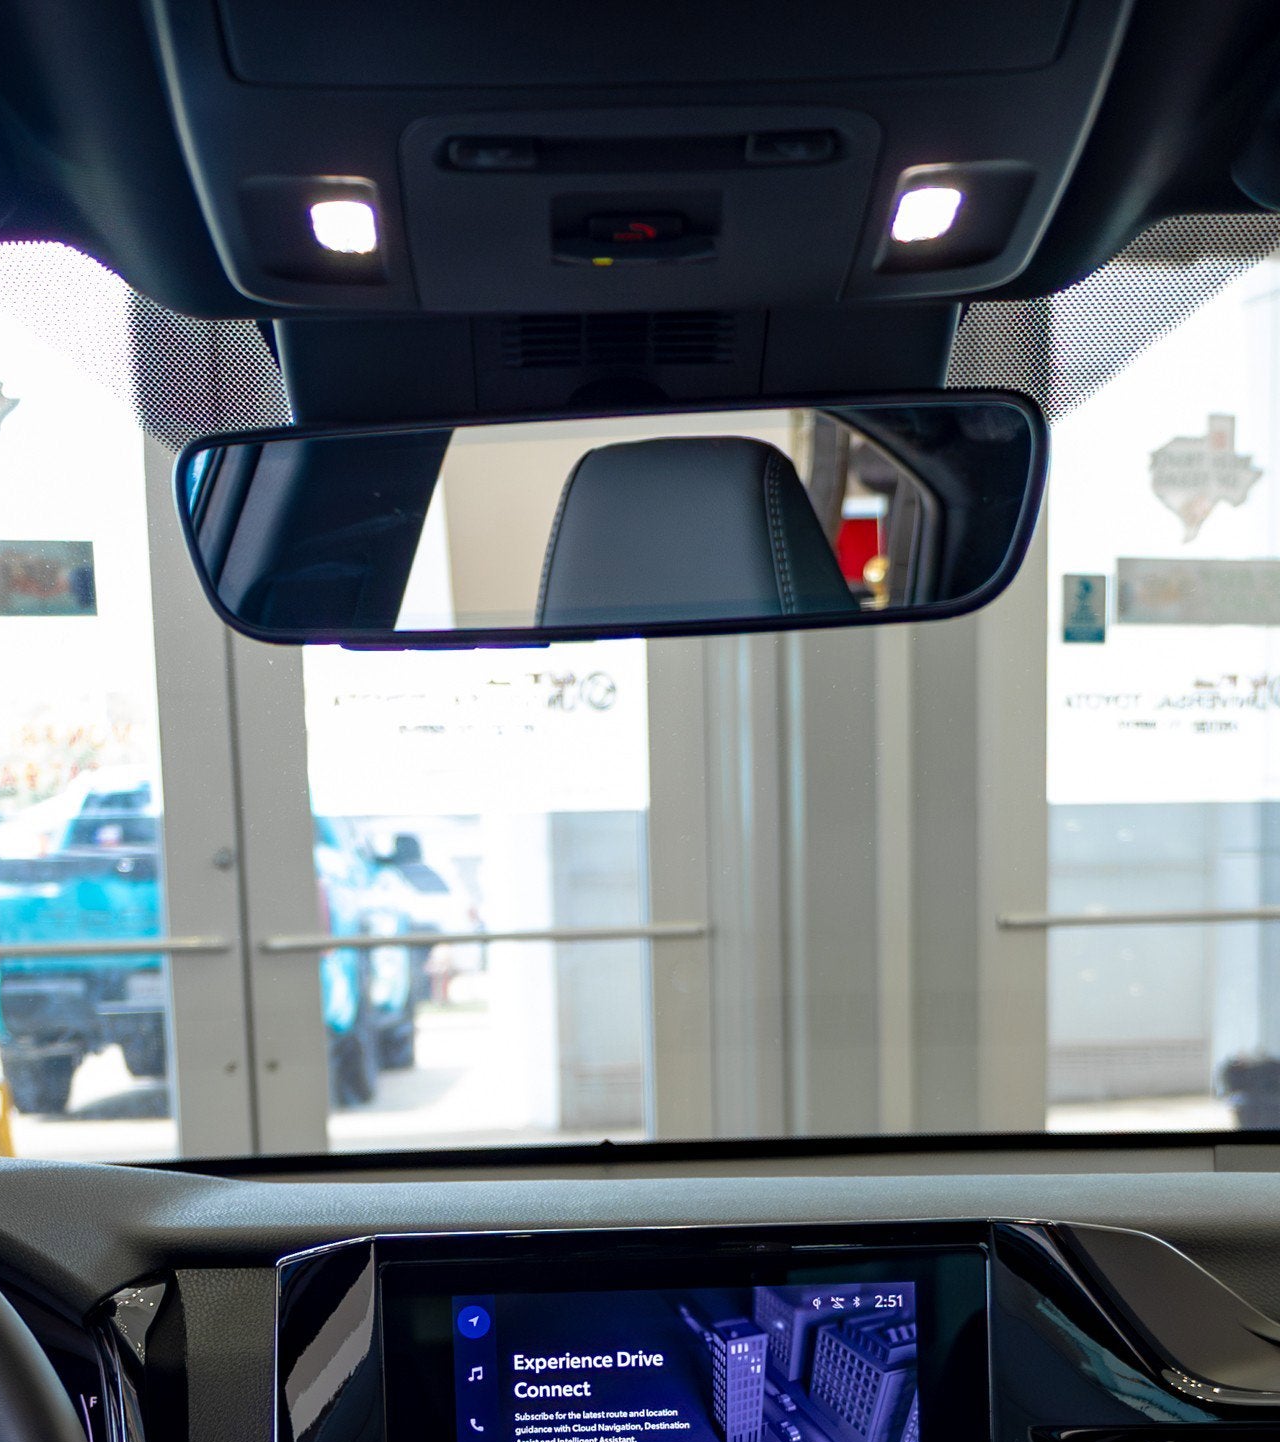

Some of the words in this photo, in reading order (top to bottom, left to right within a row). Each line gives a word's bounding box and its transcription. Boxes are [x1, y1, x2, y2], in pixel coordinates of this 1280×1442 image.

[874, 1294, 903, 1308] 2:51
[514, 1352, 613, 1374] Experience
[617, 1350, 663, 1368] Drive
[514, 1381, 591, 1398] Connect
[90, 1396, 98, 1408] F
[515, 1412, 554, 1422] Subscribe
[555, 1411, 567, 1421] for
[568, 1411, 581, 1420] the
[582, 1410, 605, 1420] latest
[606, 1411, 627, 1420] route
[628, 1409, 645, 1419] and
[646, 1409, 678, 1418] location
[515, 1425, 553, 1436] guidance
[554, 1424, 570, 1434] with
[572, 1423, 597, 1433] Cloud
[598, 1422, 643, 1434] Navigation,
[644, 1421, 690, 1431] Destination
